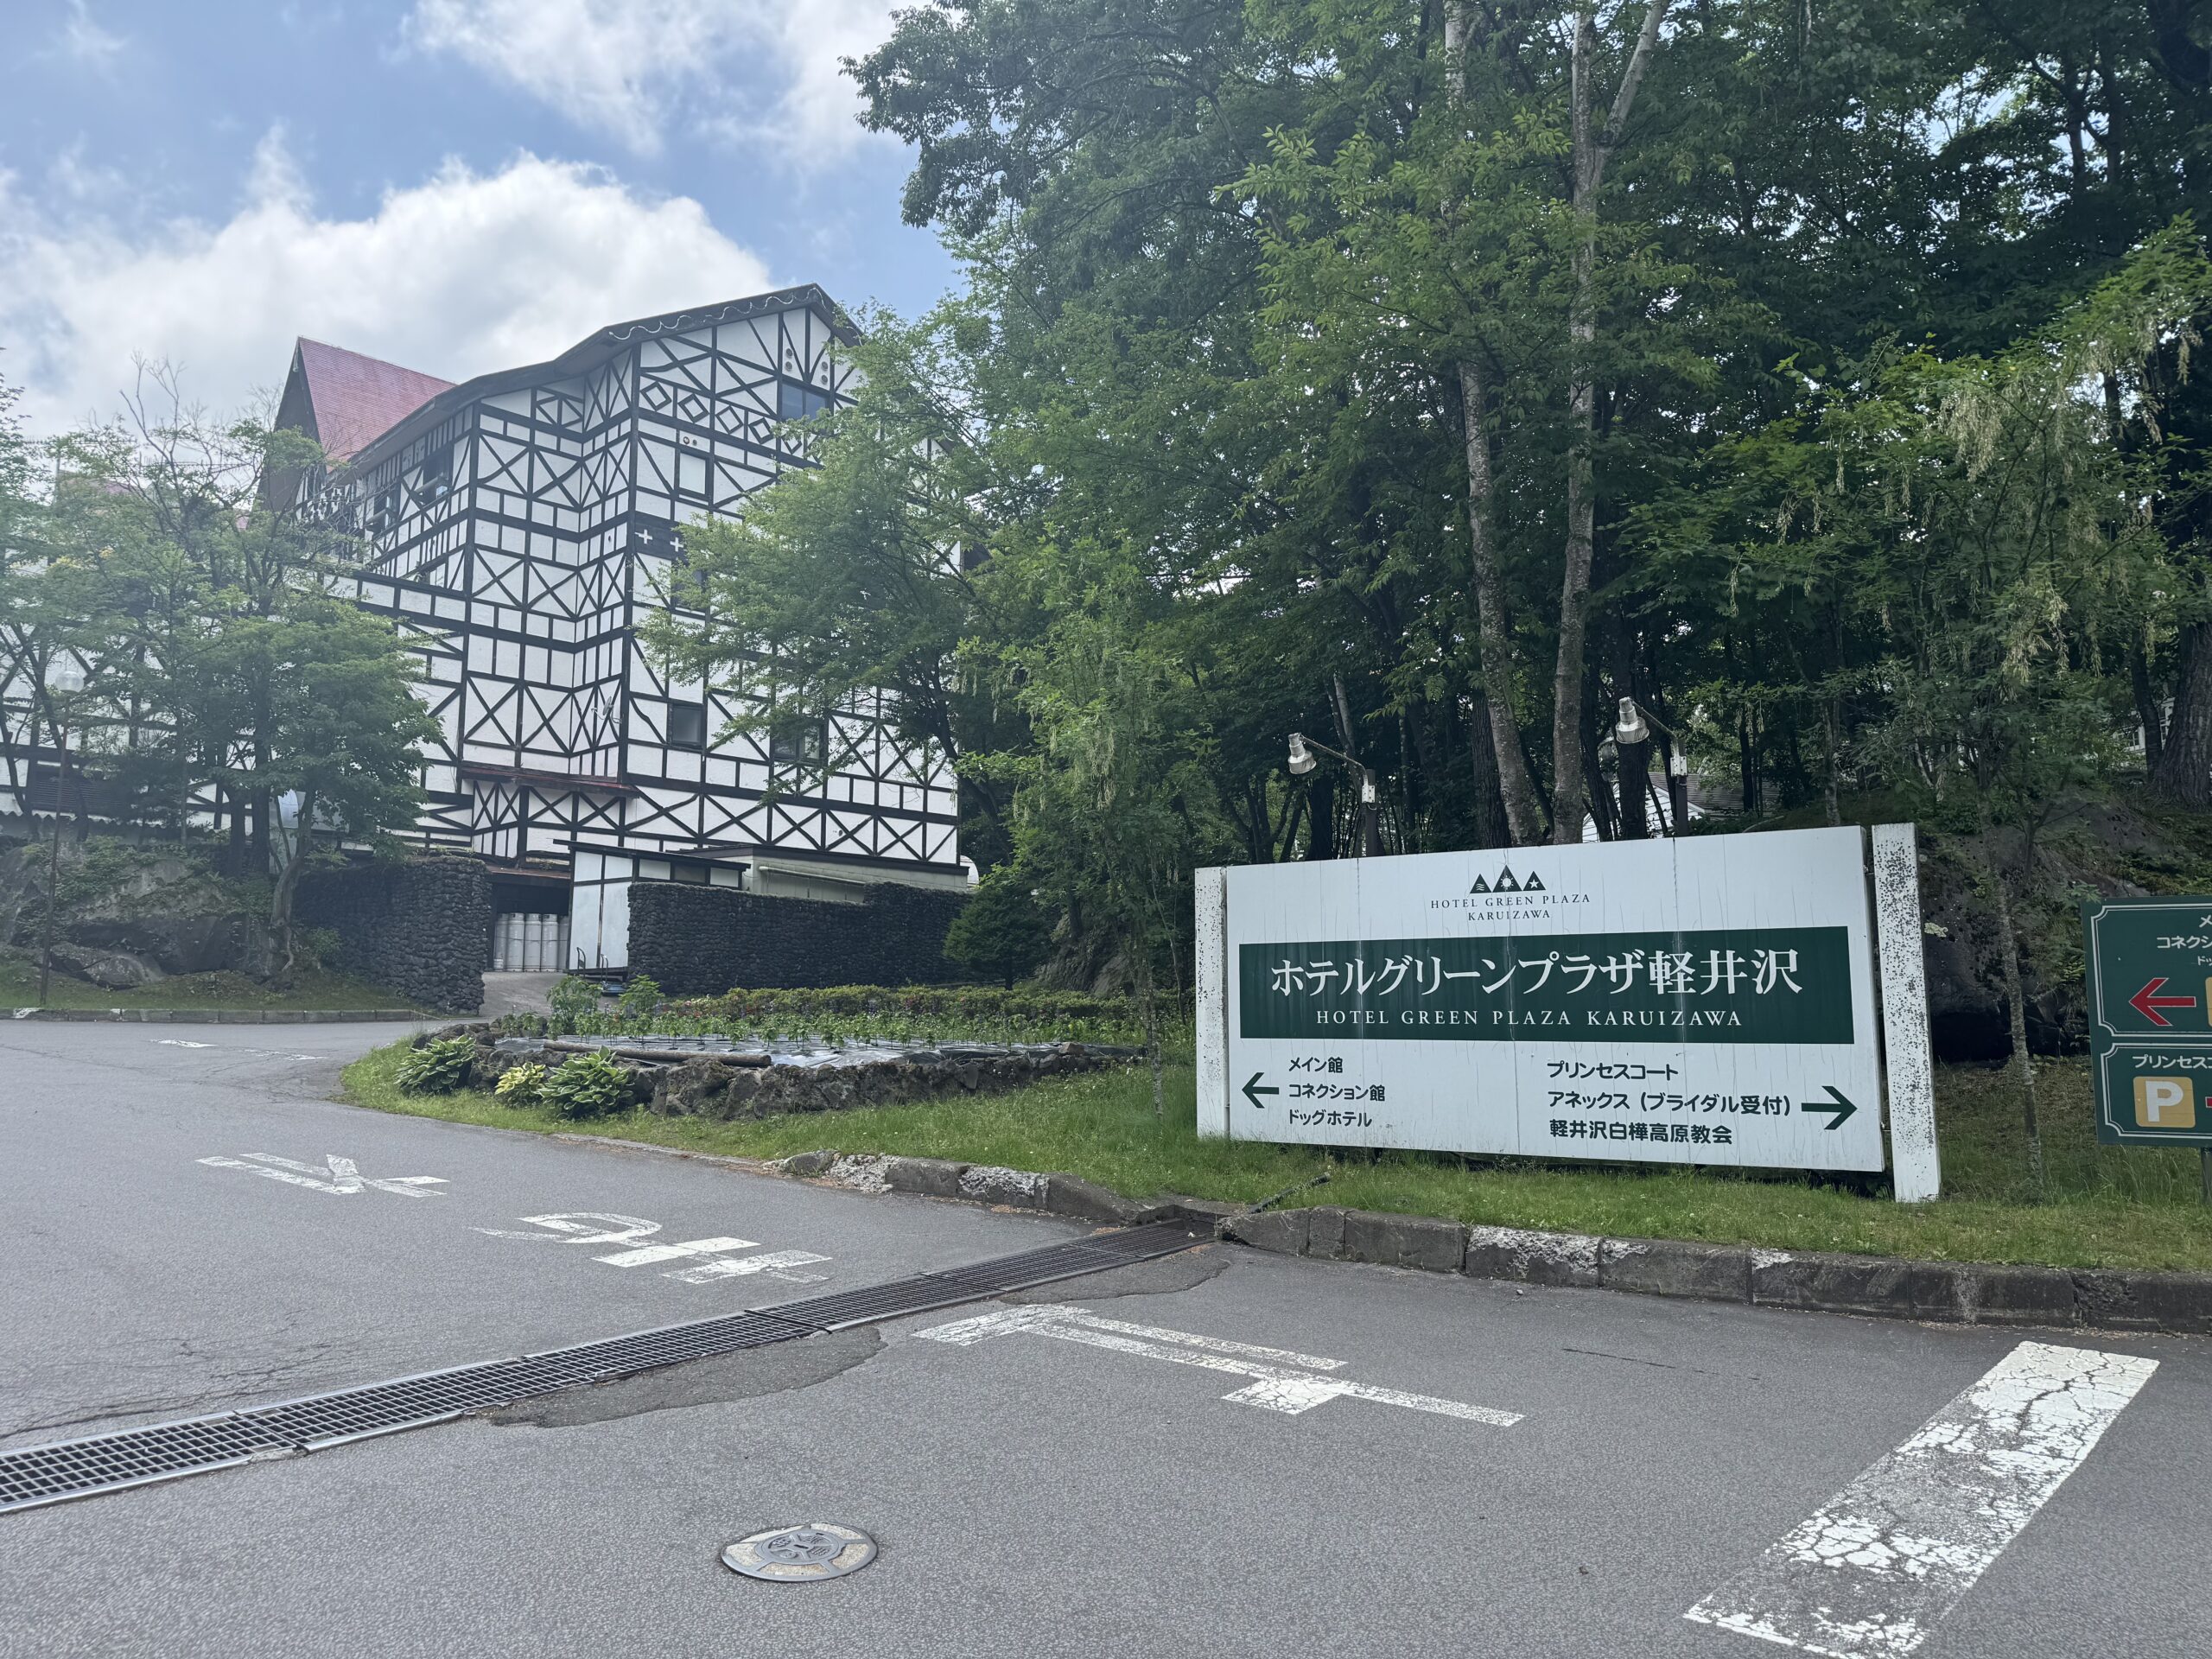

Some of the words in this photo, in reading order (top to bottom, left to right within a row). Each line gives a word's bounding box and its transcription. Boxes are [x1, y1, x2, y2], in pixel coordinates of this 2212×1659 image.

[1431, 899, 1478, 909] HOTEL
[1485, 896, 1534, 907] GREEN
[1542, 893, 1591, 905] PLAZA
[1468, 909, 1550, 921] KARUIZAWA
[1271, 949, 1803, 996] ホテルグリーンプラザ軽井沢
[1316, 1010, 1389, 1025] HOTEL
[1401, 1010, 1478, 1026] GREEN
[1492, 1010, 1572, 1026] PLAZA
[1586, 1010, 1743, 1027] KARUIZAWA
[1288, 1057, 1344, 1073] メイン館
[1547, 1060, 1679, 1081] プリンセスコート
[1288, 1083, 1386, 1102] コネクション館
[2145, 1080, 2184, 1122] P
[1289, 1109, 1373, 1128] ドッグホテル
[1549, 1119, 1733, 1145] 軽井沢白樺高原教会
